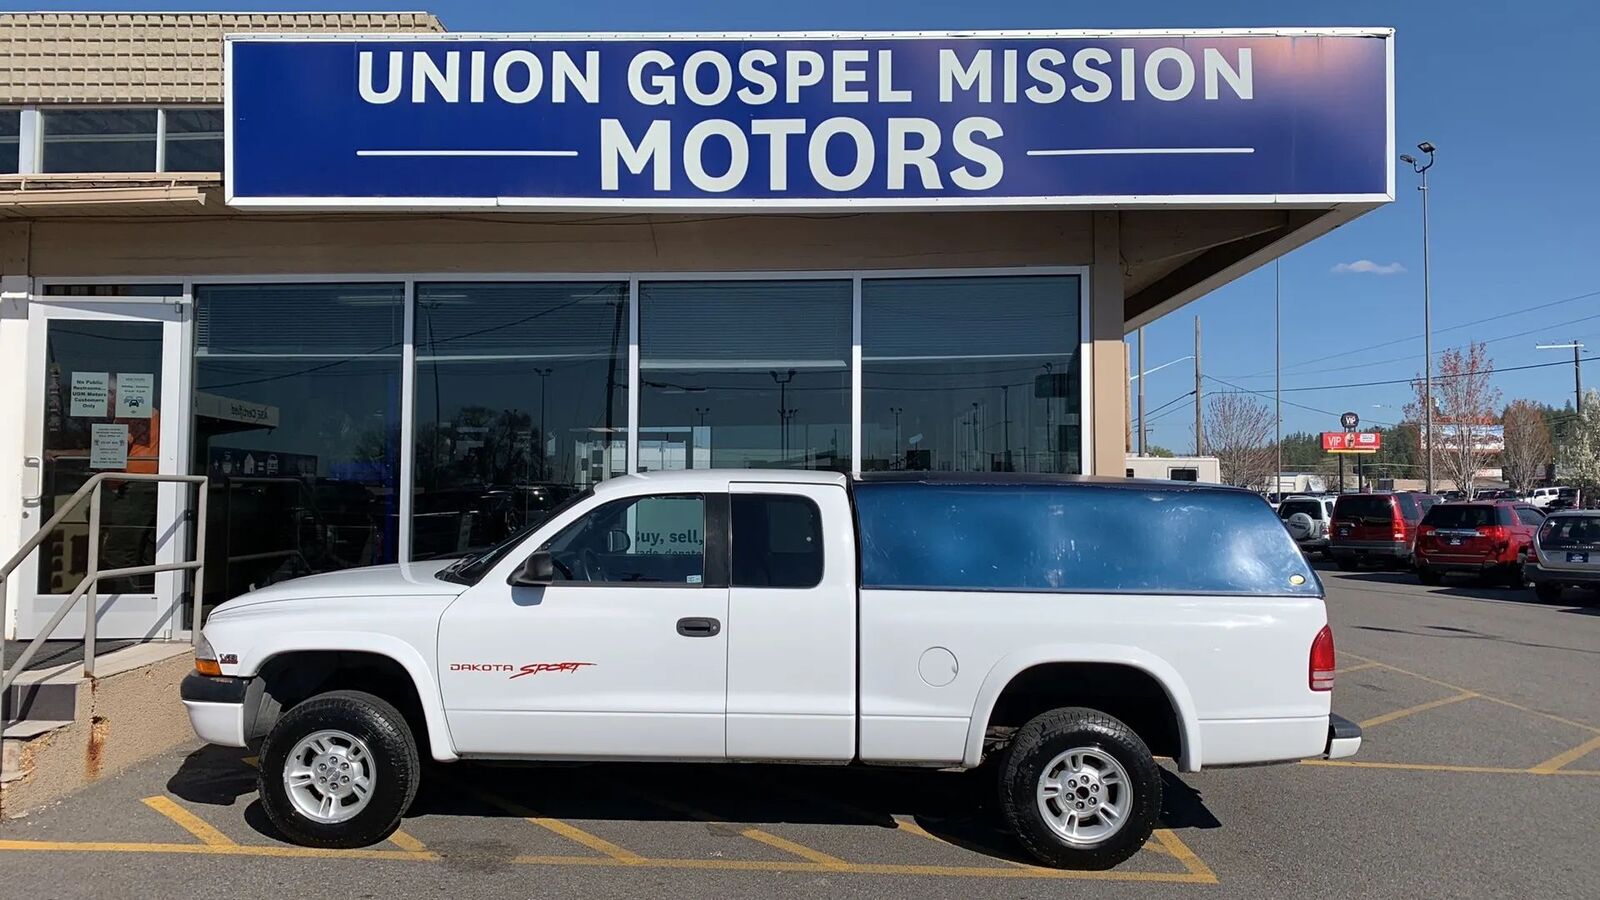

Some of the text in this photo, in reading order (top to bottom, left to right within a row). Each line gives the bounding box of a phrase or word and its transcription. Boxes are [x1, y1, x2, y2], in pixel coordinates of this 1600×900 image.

[358, 47, 1254, 106] UNION GOSPEL MISSION
[600, 117, 1004, 193] MOTORS
[1345, 415, 1356, 425] VIP
[1328, 436, 1342, 447] VIP
[669, 529, 703, 546] sell,
[450, 662, 598, 680] DAKOTA SPORT
